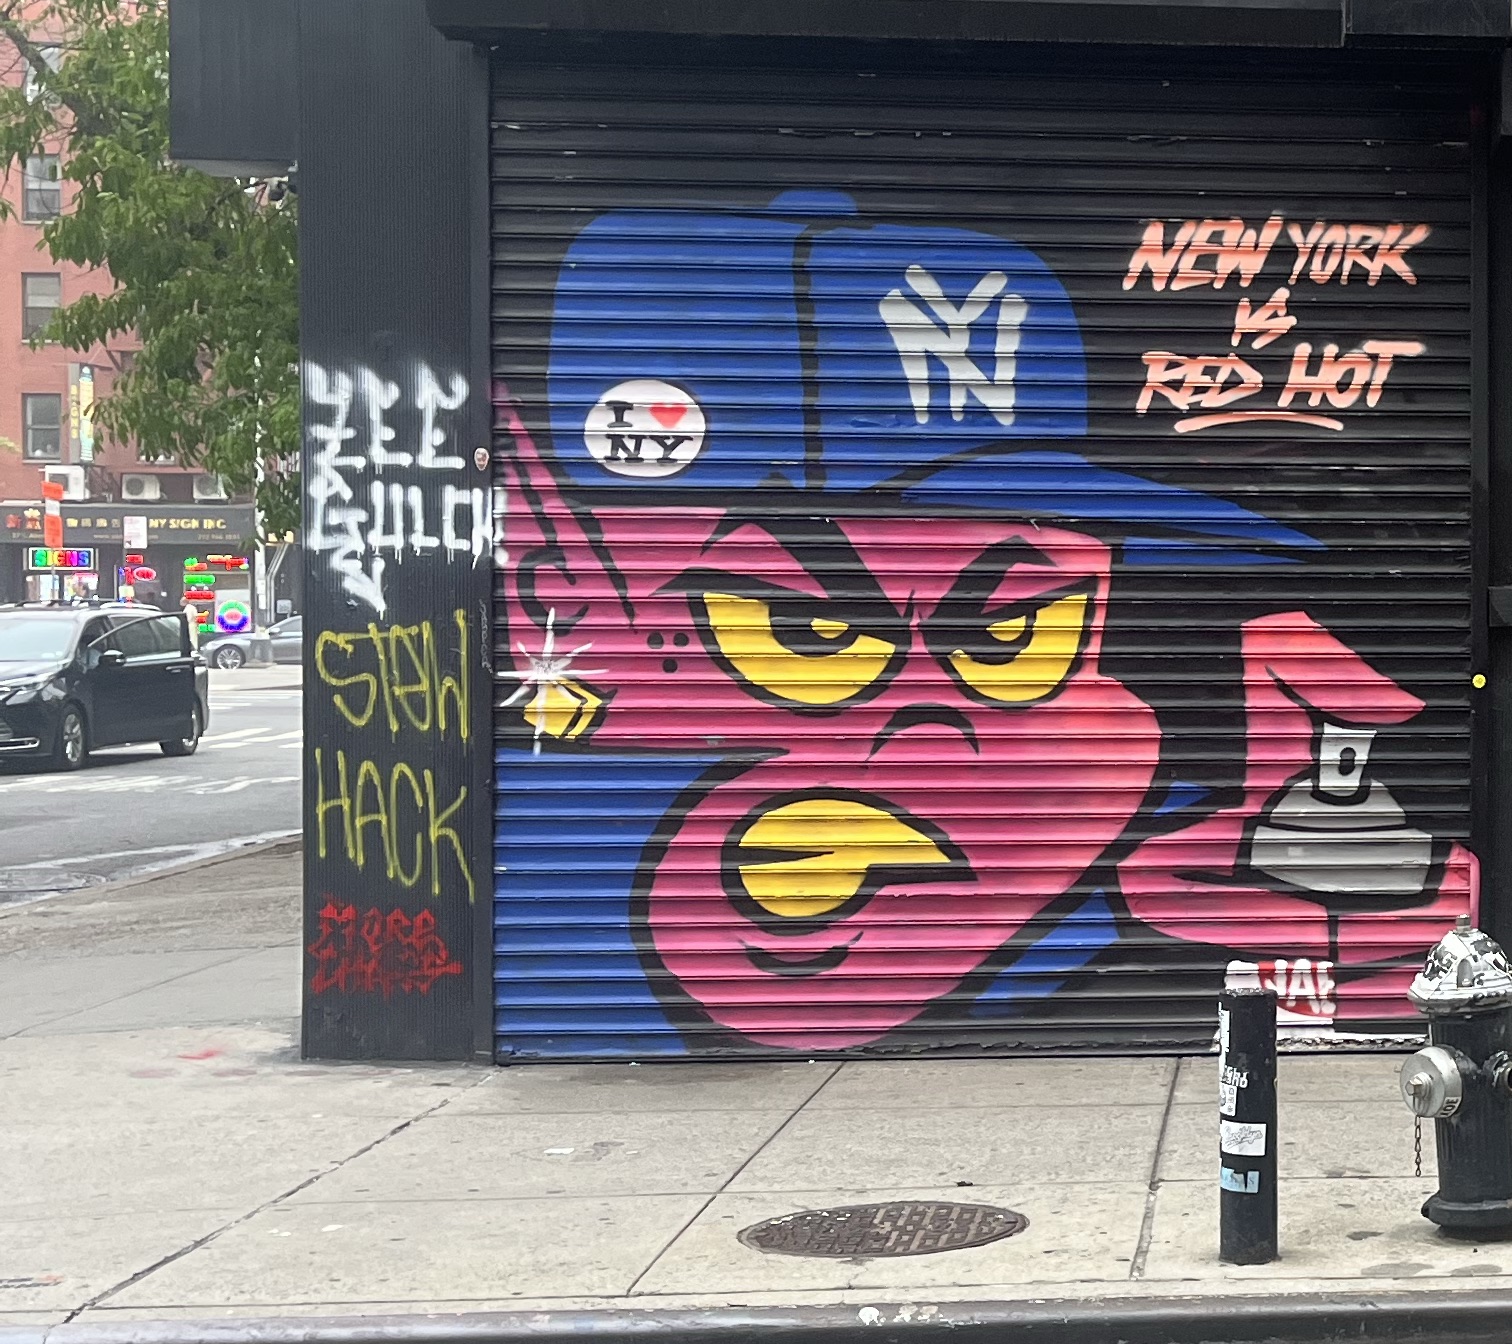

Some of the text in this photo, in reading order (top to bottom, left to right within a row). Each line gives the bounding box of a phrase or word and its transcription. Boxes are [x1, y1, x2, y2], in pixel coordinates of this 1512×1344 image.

[1122, 212, 1432, 291] NEW YORK
[1231, 287, 1297, 349] VS
[1136, 340, 1425, 416] RED HOT
[604, 400, 634, 429] I
[604, 433, 693, 465] NY
[148, 518, 227, 529] NY SIGN INC
[34, 549, 90, 567] SIGNS
[315, 747, 476, 904] HACK
